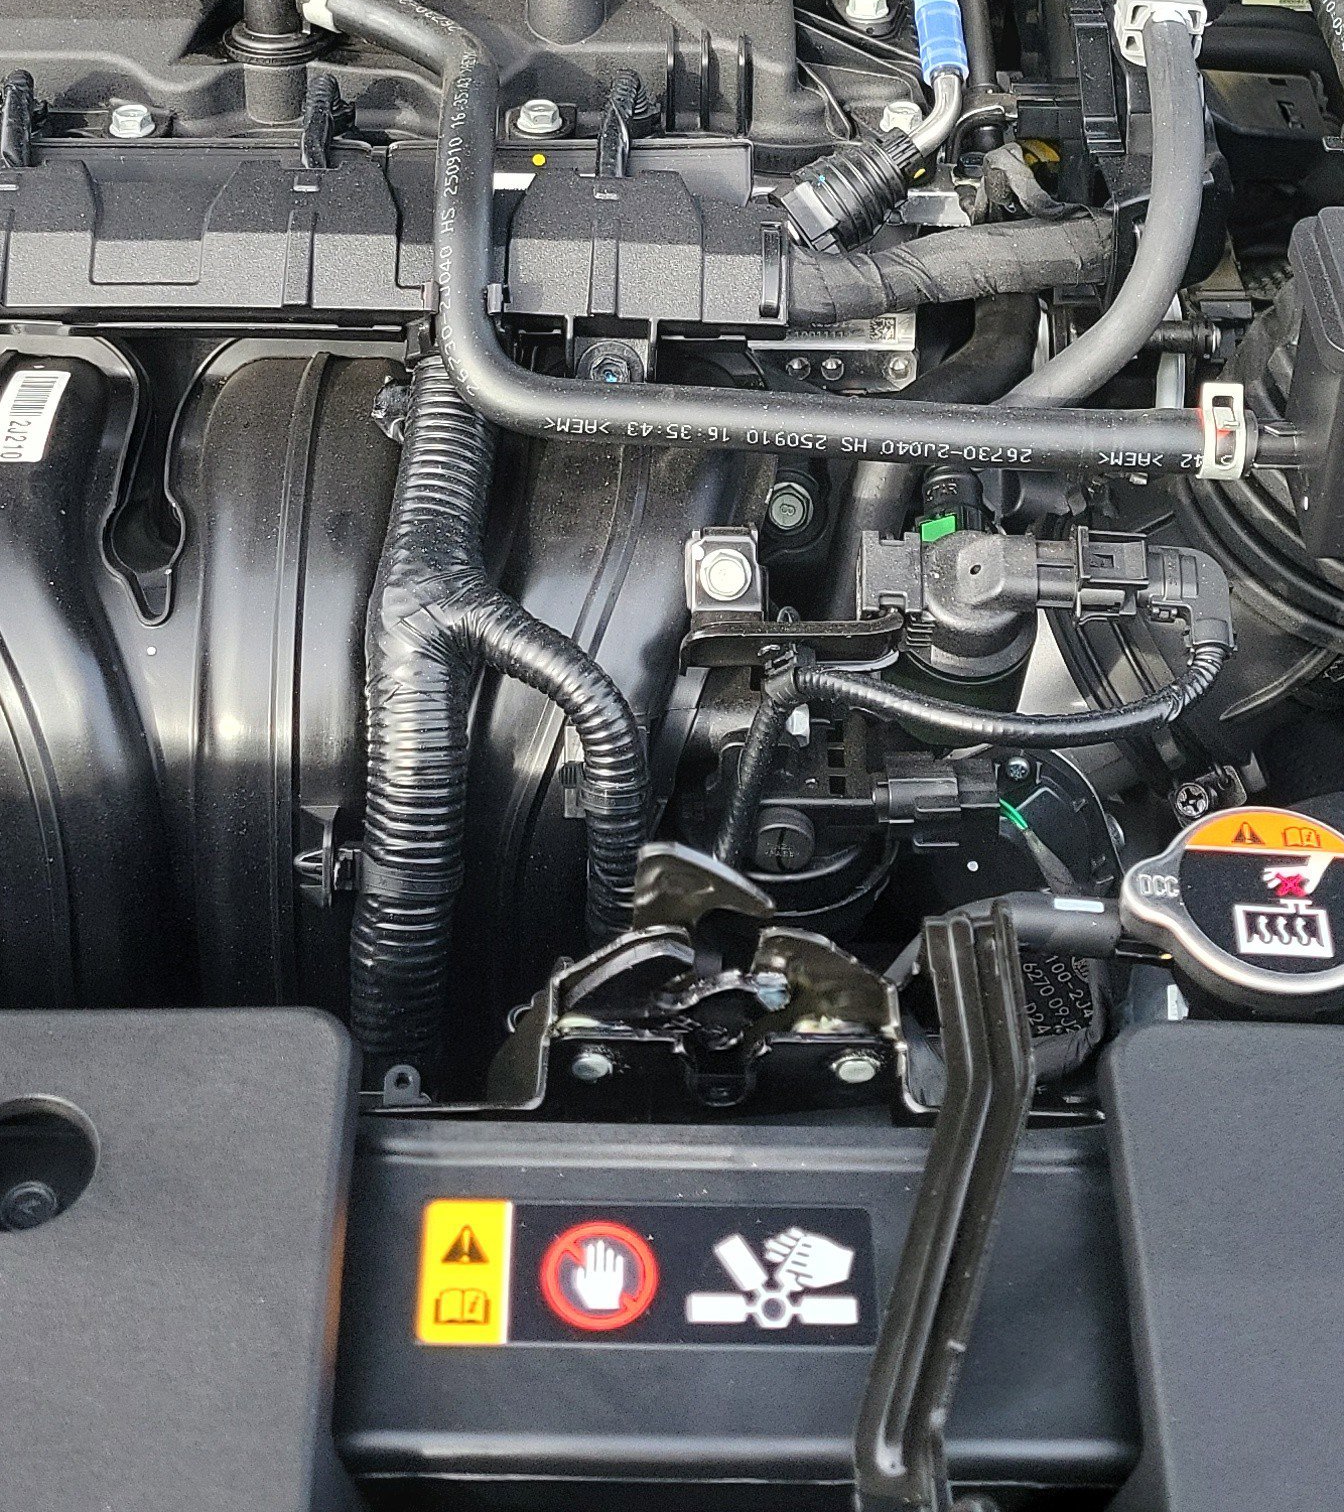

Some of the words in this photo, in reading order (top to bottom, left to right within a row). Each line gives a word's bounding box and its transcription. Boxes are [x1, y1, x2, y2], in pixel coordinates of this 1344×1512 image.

[442, 135, 463, 196] 250910
[440, 207, 456, 233] HS
[544, 416, 613, 435] >AEM<
[626, 420, 730, 444] 16:35:43
[0, 419, 30, 461] 2J210
[745, 427, 828, 451] 250910
[840, 435, 869, 454] HS
[881, 439, 1033, 464] 26730-2J040
